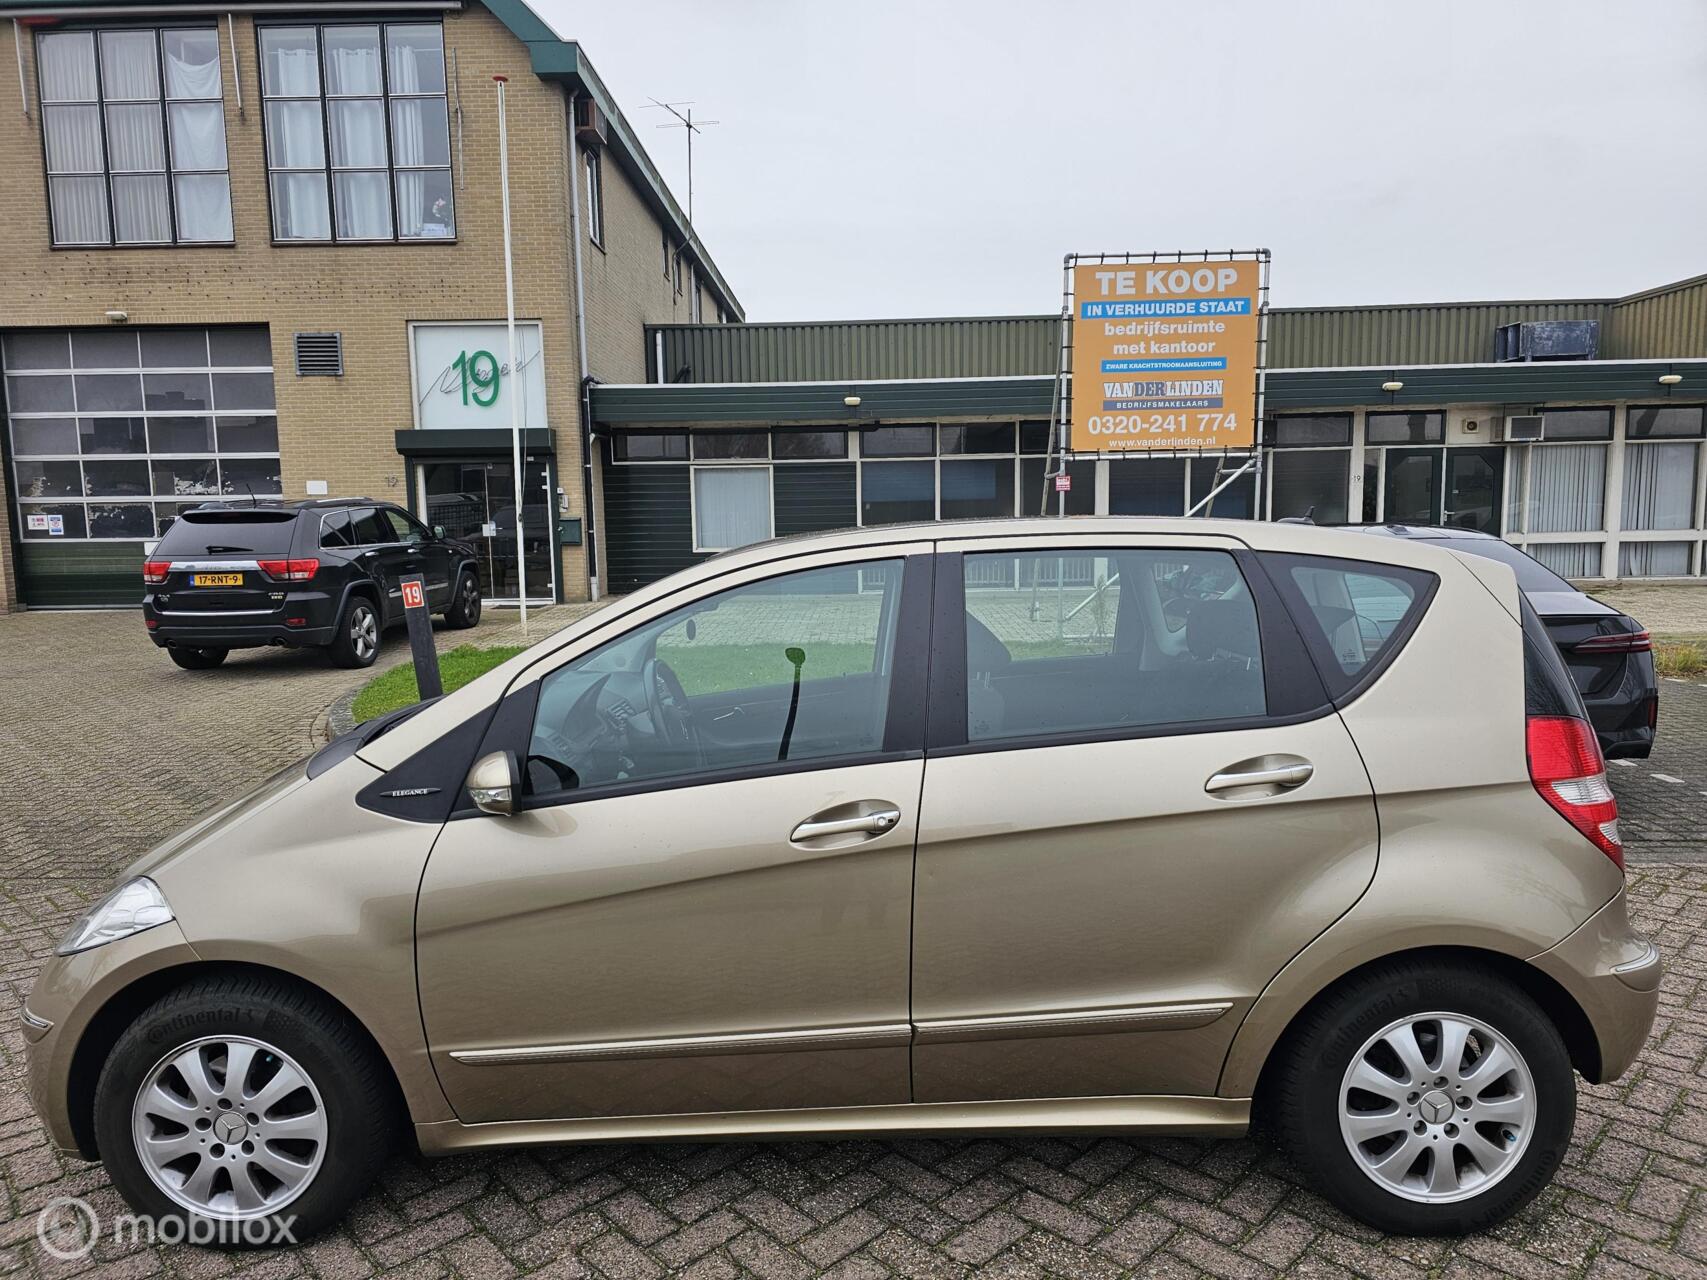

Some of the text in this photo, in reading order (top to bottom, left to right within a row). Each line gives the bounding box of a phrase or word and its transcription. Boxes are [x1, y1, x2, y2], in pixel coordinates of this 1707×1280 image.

[1096, 268, 1238, 295] TE KOOP
[1087, 301, 1245, 316] IN VERHUURDE STAAT
[1104, 320, 1225, 336] bedrijfsruimte
[1113, 340, 1216, 355] met kantoor
[1106, 361, 1222, 370] ZWARE KRACHTSTROOMAANSLUITING
[451, 350, 500, 407] 19
[1103, 379, 1224, 398] VANDERLINDEN
[1116, 400, 1209, 409] BEDRIJFSMAKELAARS
[1088, 413, 1237, 435] 0320-241 774
[1109, 436, 1216, 448] www.vanderlinden.nl
[199, 575, 239, 585] 17-RNT-9
[405, 586, 421, 604] 19
[392, 788, 428, 797] ELEGANCE
[148, 1007, 241, 1043] Continental
